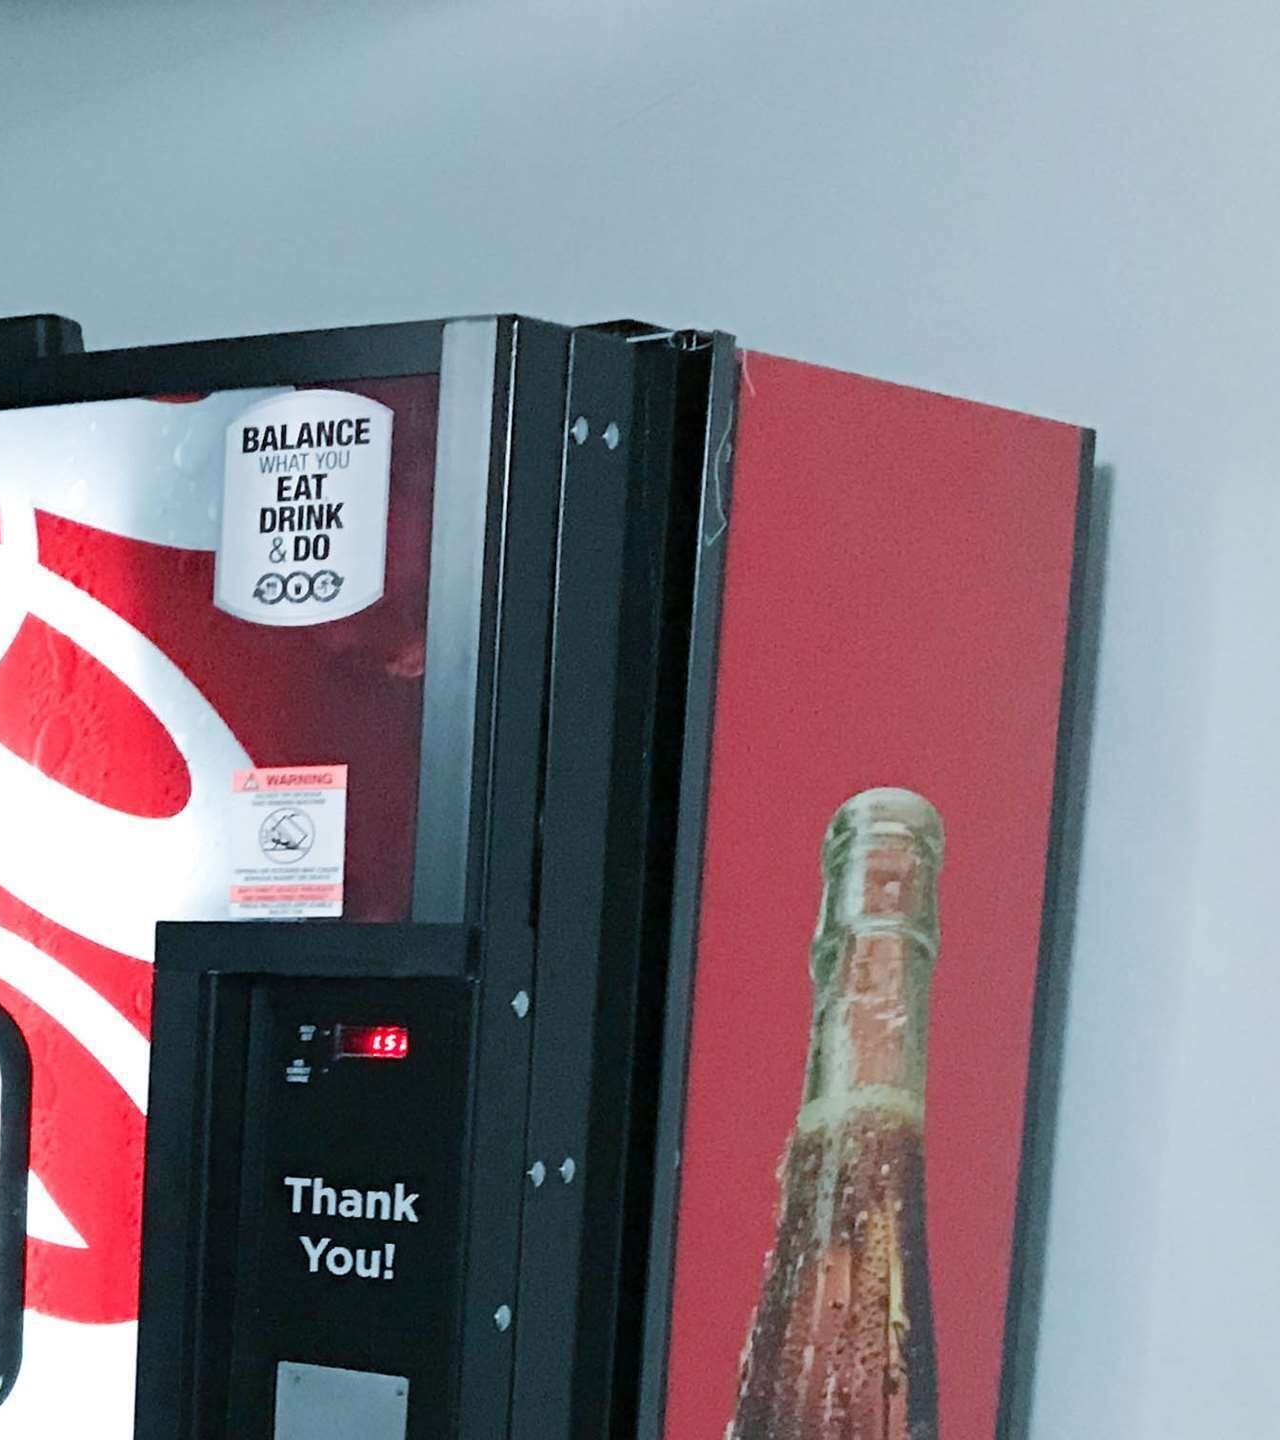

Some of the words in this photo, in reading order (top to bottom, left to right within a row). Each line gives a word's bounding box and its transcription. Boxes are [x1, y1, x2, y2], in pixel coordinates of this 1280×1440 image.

[242, 418, 371, 453] BALANCE
[259, 452, 309, 474] WHAT
[315, 450, 351, 470] YOU
[277, 473, 328, 502] EAT
[259, 502, 344, 534] DRINK
[268, 536, 287, 563] &
[293, 533, 330, 562] DO
[266, 772, 333, 786] WARNING
[284, 1176, 420, 1223] Thank
[299, 1235, 396, 1280] You!
